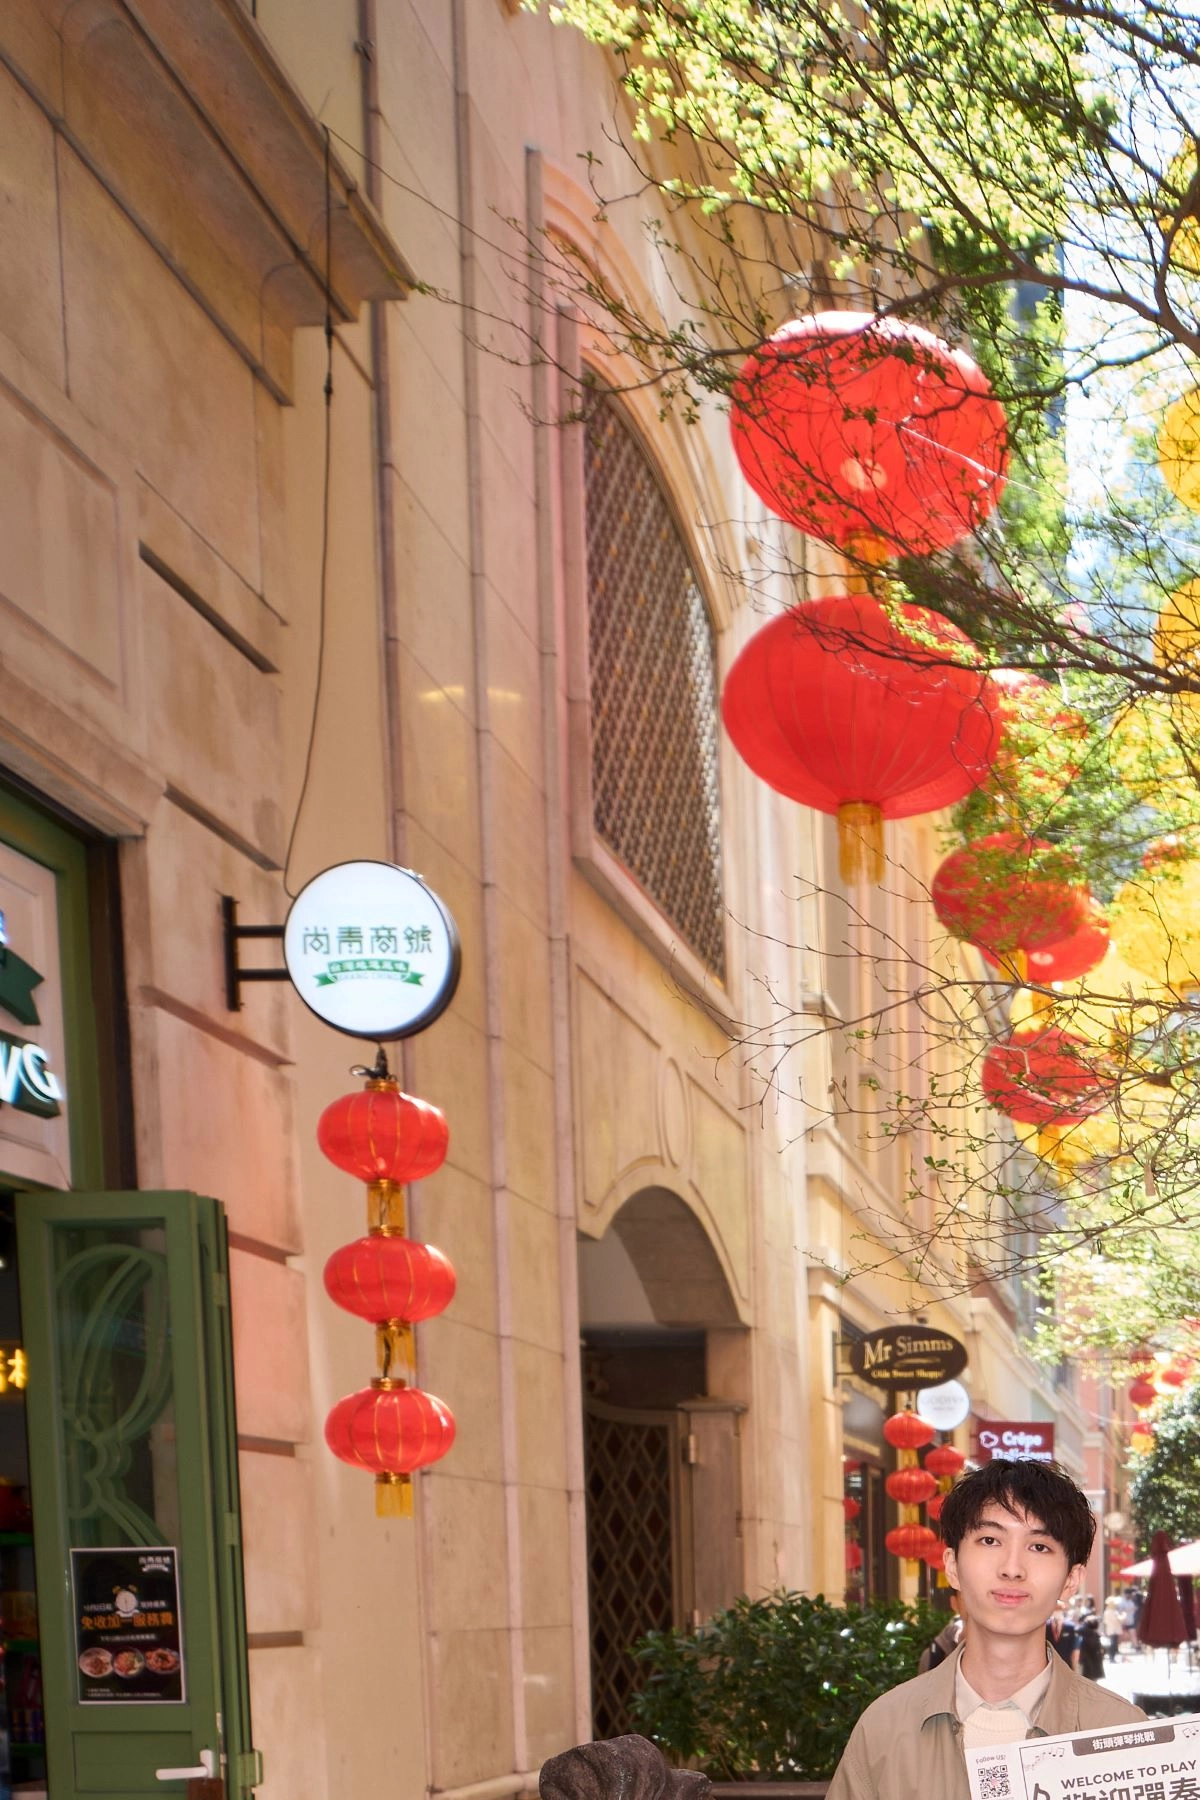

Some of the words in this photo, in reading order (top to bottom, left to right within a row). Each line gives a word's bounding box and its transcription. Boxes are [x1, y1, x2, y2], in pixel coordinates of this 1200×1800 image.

[303, 925, 432, 954] 尚青商號
[863, 1338, 892, 1370] Mr
[896, 1336, 954, 1356] Simms
[1092, 1731, 1155, 1750] 街頭彈琴挑戰
[1061, 1769, 1134, 1789] WELCOME
[1137, 1766, 1157, 1778] TO
[1161, 1760, 1197, 1775] PLAY
